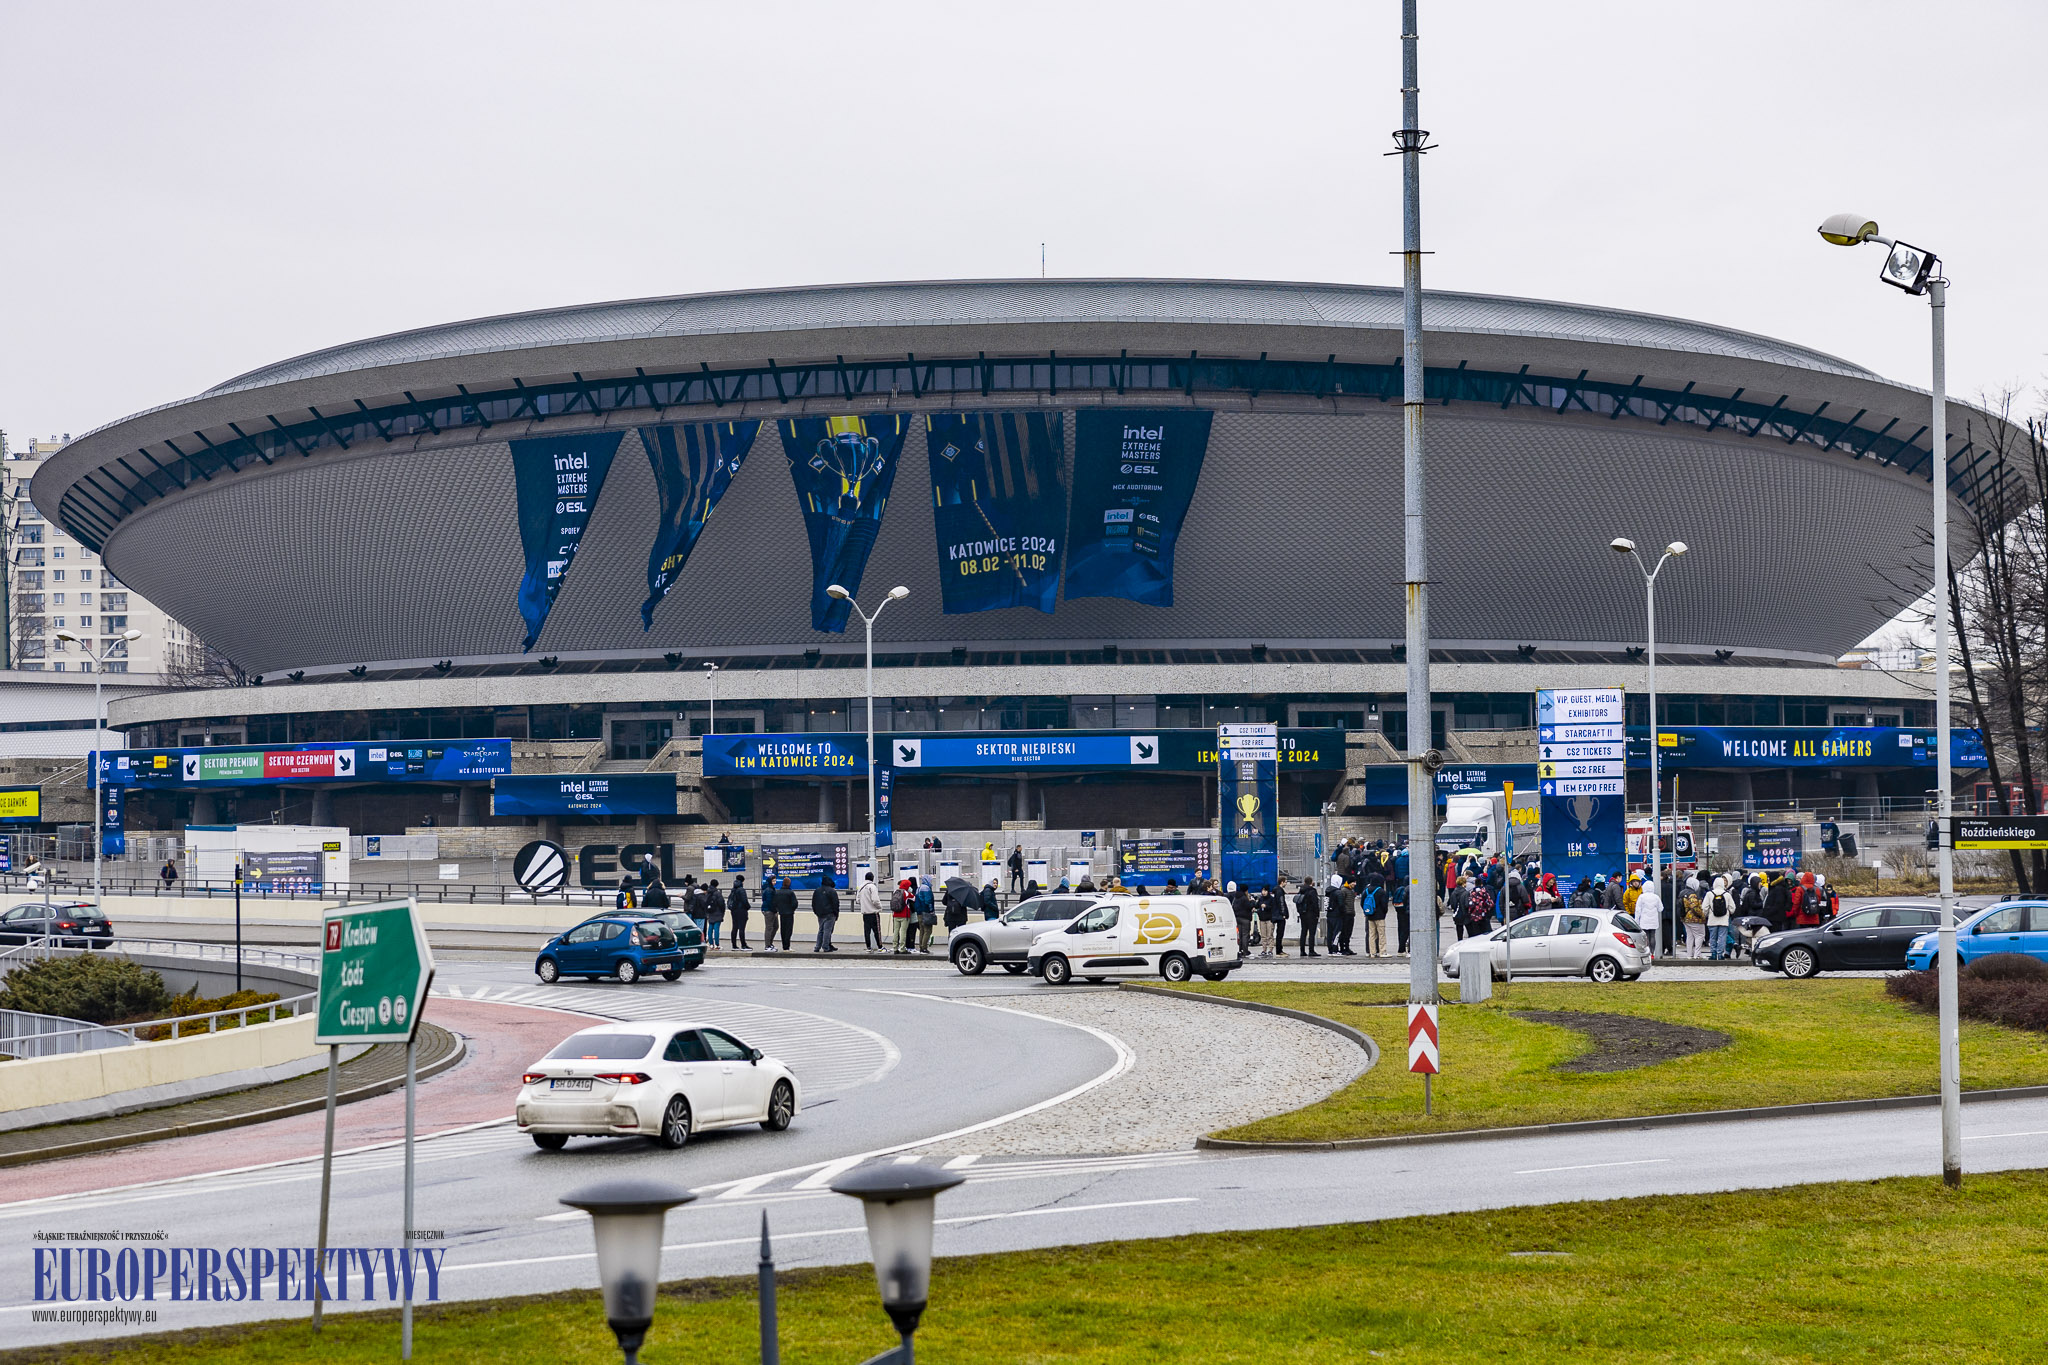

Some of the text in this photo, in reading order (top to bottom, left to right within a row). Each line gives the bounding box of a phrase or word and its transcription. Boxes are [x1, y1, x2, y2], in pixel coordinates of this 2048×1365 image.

[1124, 425, 1163, 440] intel
[1122, 442, 1161, 451] EXTREME
[554, 452, 588, 470] intel
[1121, 451, 1160, 460] MASTERS
[1134, 465, 1158, 474] ESL
[556, 472, 587, 484] EXTREME
[557, 484, 588, 495] MASTERS
[566, 502, 586, 512] ESL
[1106, 512, 1128, 520] intel
[949, 536, 1055, 560] KATOWICE 2024
[960, 556, 1000, 576] 08.02
[1014, 553, 1046, 571] 11.02
[1568, 709, 1608, 717] EXHIBITORS
[1565, 729, 1605, 737] STARCRAFT
[758, 743, 831, 755] WELCOME TO
[977, 743, 1075, 755] SEKTOR NIEBIESKI
[1282, 738, 1296, 749] TO
[1723, 740, 1872, 756] WELCOME ALL GAMERS
[1198, 751, 1319, 762] IEM 2024
[1566, 747, 1612, 756] CS2 TICKETS
[204, 757, 259, 768] SEKTOR PREMIUM
[269, 754, 334, 766] SEKTOR CZERWONY
[735, 755, 854, 768] IEM KATOWICE 2024
[1437, 771, 1462, 782] intel
[561, 781, 584, 792] intel
[1563, 784, 1576, 792] IEM
[1579, 784, 1597, 792] EXPO
[1961, 827, 2035, 838] Roździeńskiego
[1568, 843, 1581, 851] IEM
[580, 843, 697, 890] ESL
[330, 920, 378, 947] 79 Kraków
[341, 960, 364, 987] Łódź
[340, 1000, 376, 1033] Cieszyn
[382, 1003, 389, 1019] PL
[556, 1080, 565, 1088] SH
